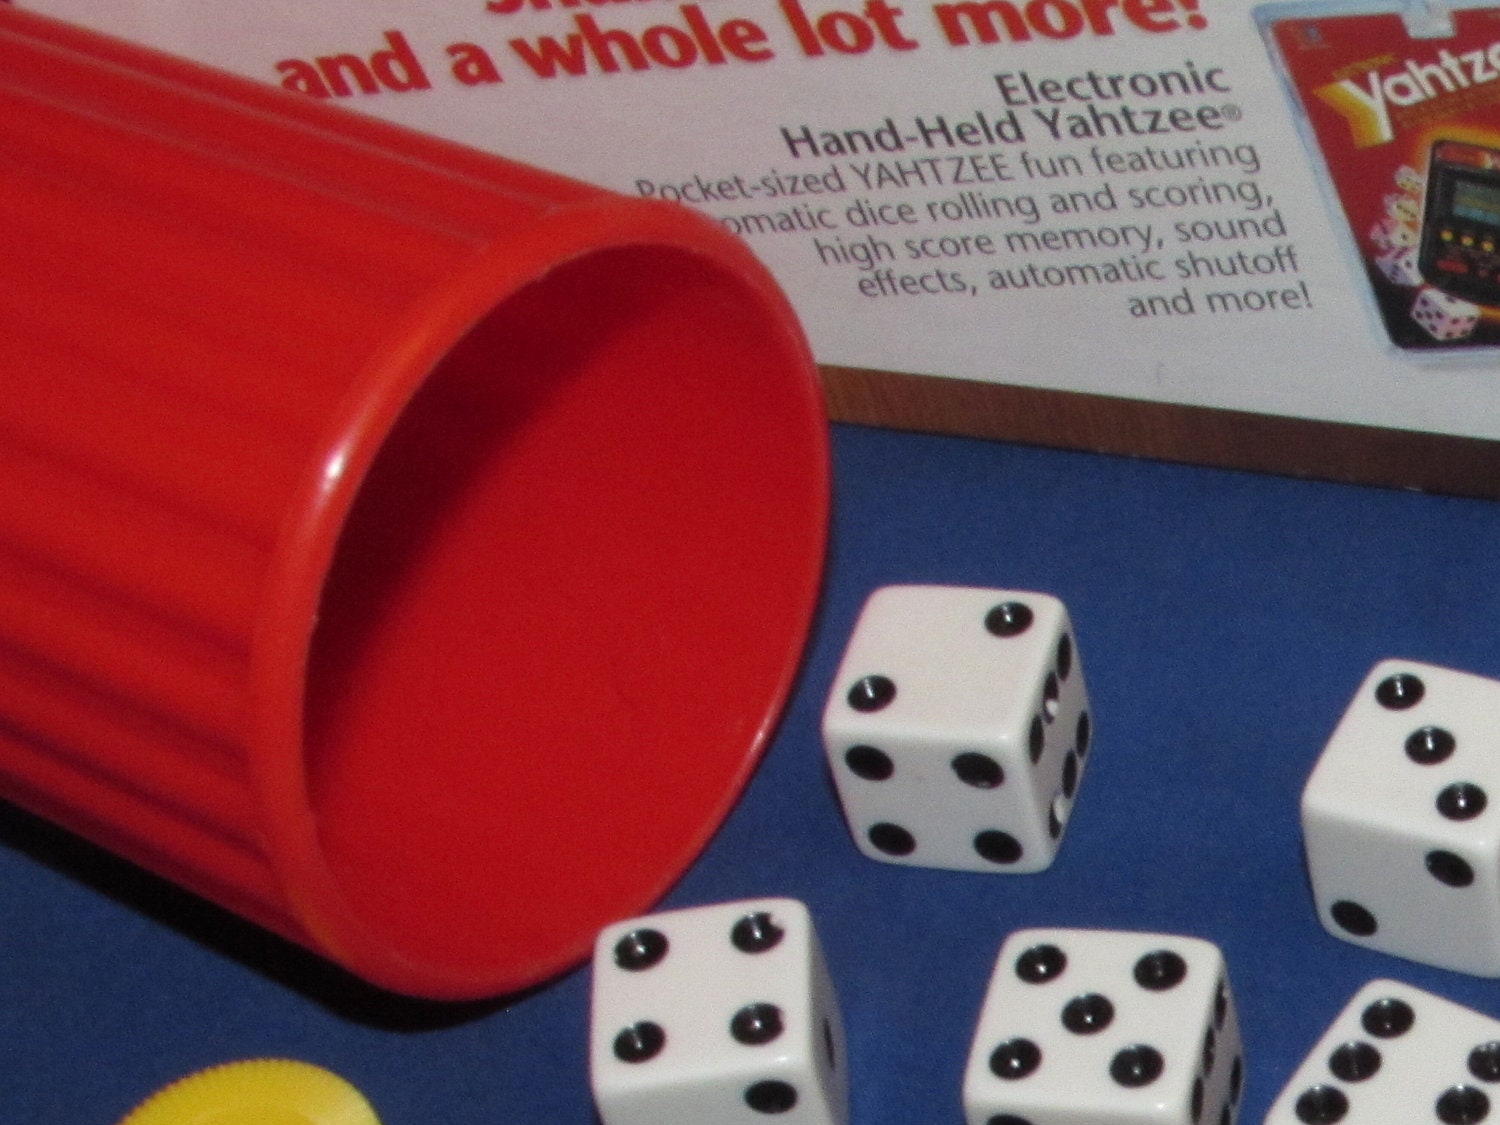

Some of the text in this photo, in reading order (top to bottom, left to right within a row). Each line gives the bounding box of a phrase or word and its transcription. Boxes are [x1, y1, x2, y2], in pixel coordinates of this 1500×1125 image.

[275, 0, 1208, 98] and a whole lot more!
[994, 61, 1230, 106] Electronic
[780, 110, 1026, 158] Hand-Held
[635, 140, 1260, 202] Pocket-sized YAHTZEE fun featuring
[846, 182, 1272, 226] dice rolling and scoring,
[814, 210, 1286, 270] high score memory, sound
[859, 246, 1300, 297] effects, automatic shutoff
[1130, 281, 1312, 317] and more!
